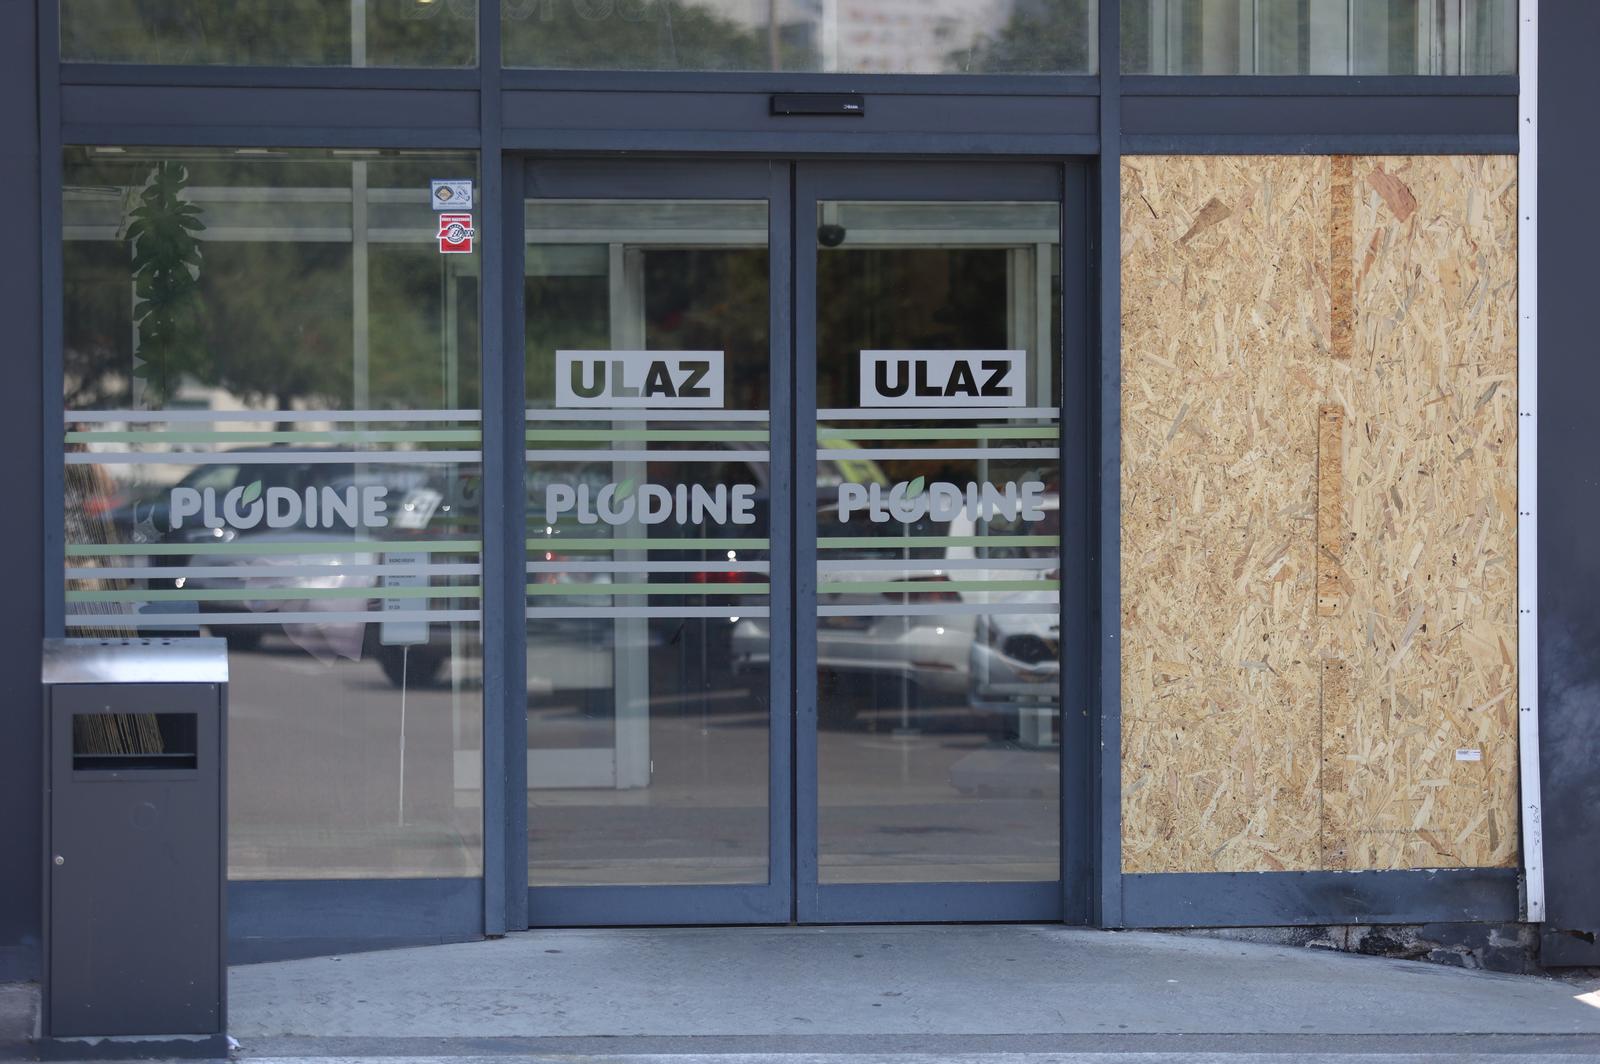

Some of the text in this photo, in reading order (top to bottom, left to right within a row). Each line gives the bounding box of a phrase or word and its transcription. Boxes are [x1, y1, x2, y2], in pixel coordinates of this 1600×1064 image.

[570, 360, 711, 398] ULAZ
[874, 360, 1013, 397] ULAZ
[170, 485, 389, 530] PLODINE
[545, 483, 756, 525] PLODINE
[838, 481, 1046, 523] PLODINE
